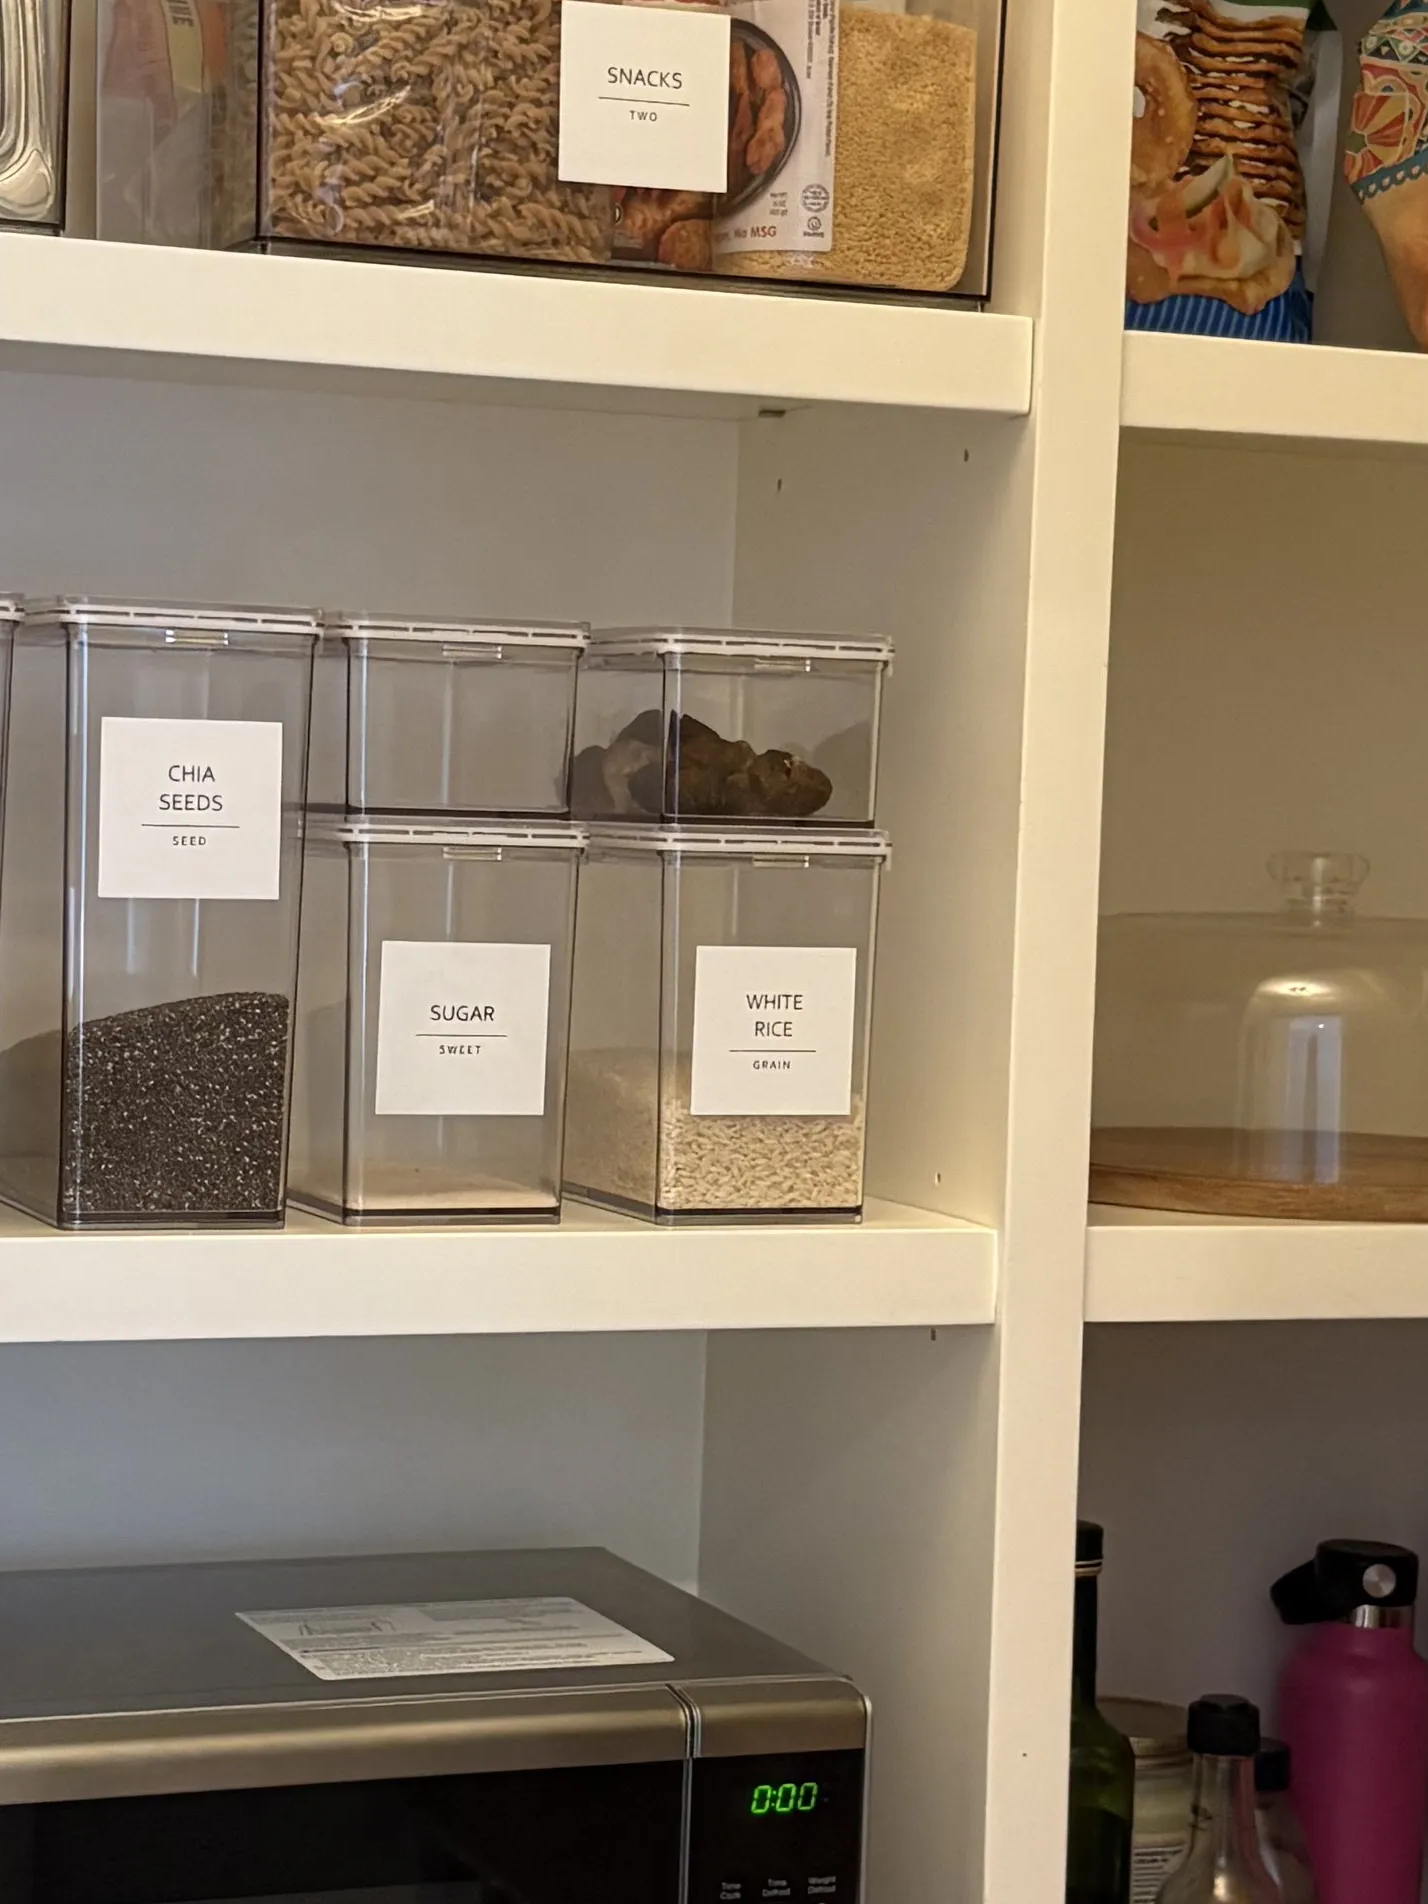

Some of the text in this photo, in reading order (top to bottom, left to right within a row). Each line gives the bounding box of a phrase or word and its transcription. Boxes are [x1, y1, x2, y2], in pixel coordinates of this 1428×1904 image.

[607, 67, 683, 89] SNACKS
[630, 110, 658, 122] TWO
[167, 764, 216, 784] CHIA
[158, 791, 225, 813] SEEDS
[171, 834, 208, 848] SEED
[745, 992, 804, 1012] WHITE
[429, 1003, 496, 1025] SUGAR
[754, 1019, 793, 1039] RICE
[438, 1044, 483, 1056] SWEET
[752, 1059, 792, 1072] GRAIN
[750, 1782, 818, 1815] 0:00
